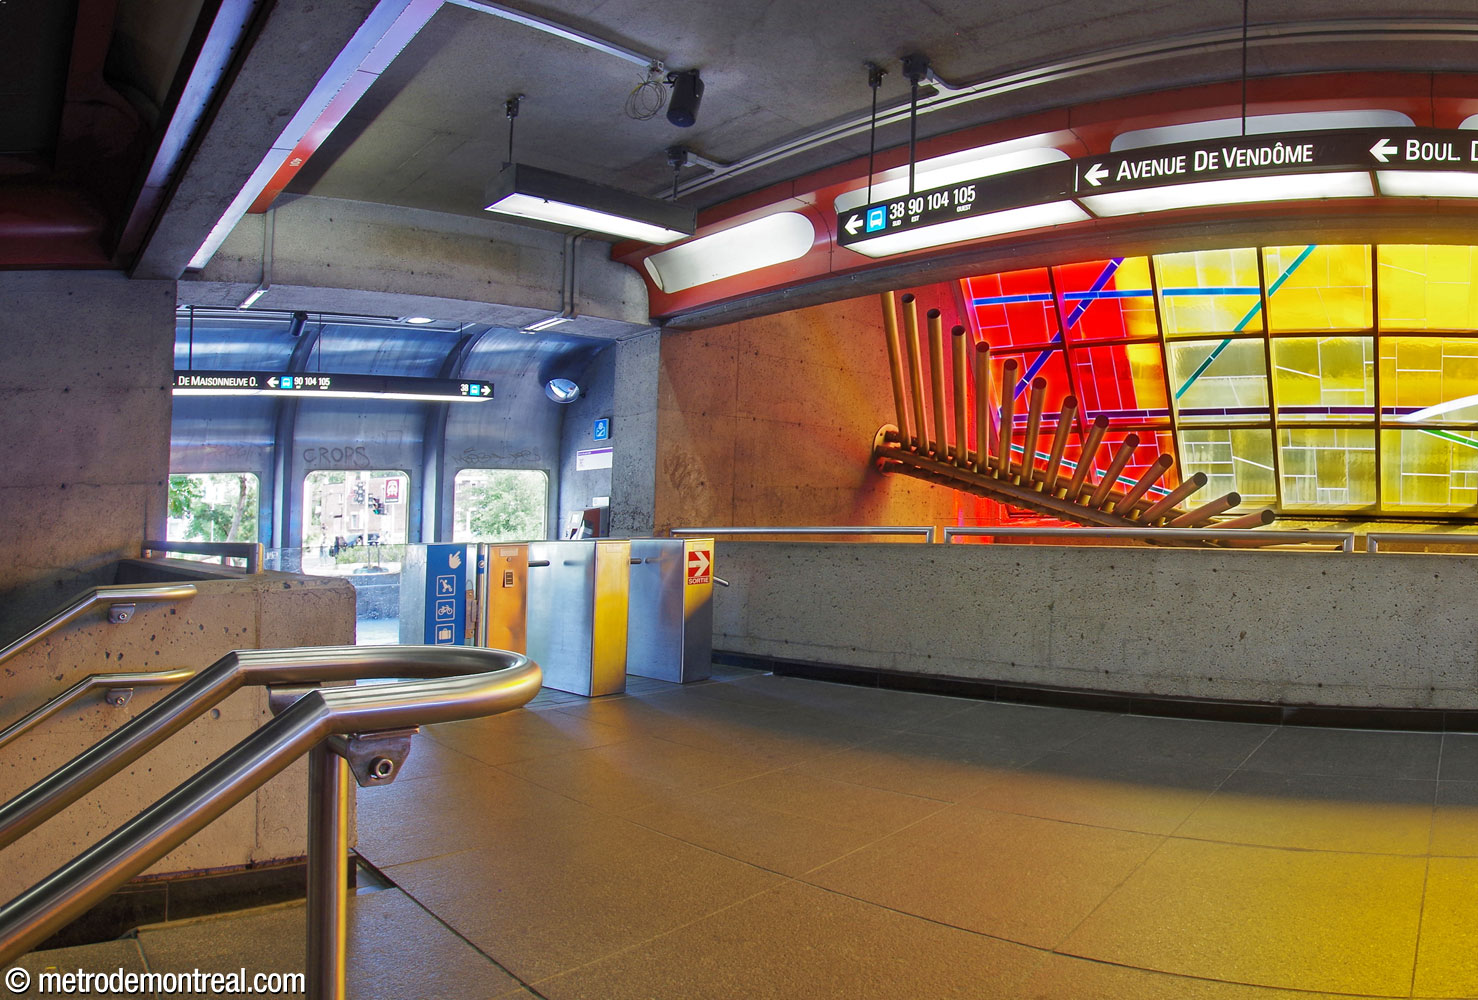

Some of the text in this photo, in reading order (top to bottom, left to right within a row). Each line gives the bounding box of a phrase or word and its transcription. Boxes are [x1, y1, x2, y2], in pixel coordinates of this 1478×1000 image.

[1405, 139, 1461, 161] BOUL.
[1116, 142, 1313, 181] AVENUE DE VENDÔME
[889, 185, 976, 220] 38 90 104 105
[956, 203, 972, 213] OUEST
[178, 375, 190, 386] DE
[190, 375, 249, 387] MAISONNEUVE
[249, 376, 259, 387] O.
[294, 376, 330, 386] 90 104 105
[460, 383, 469, 392] 38
[303, 446, 372, 468] CROPS
